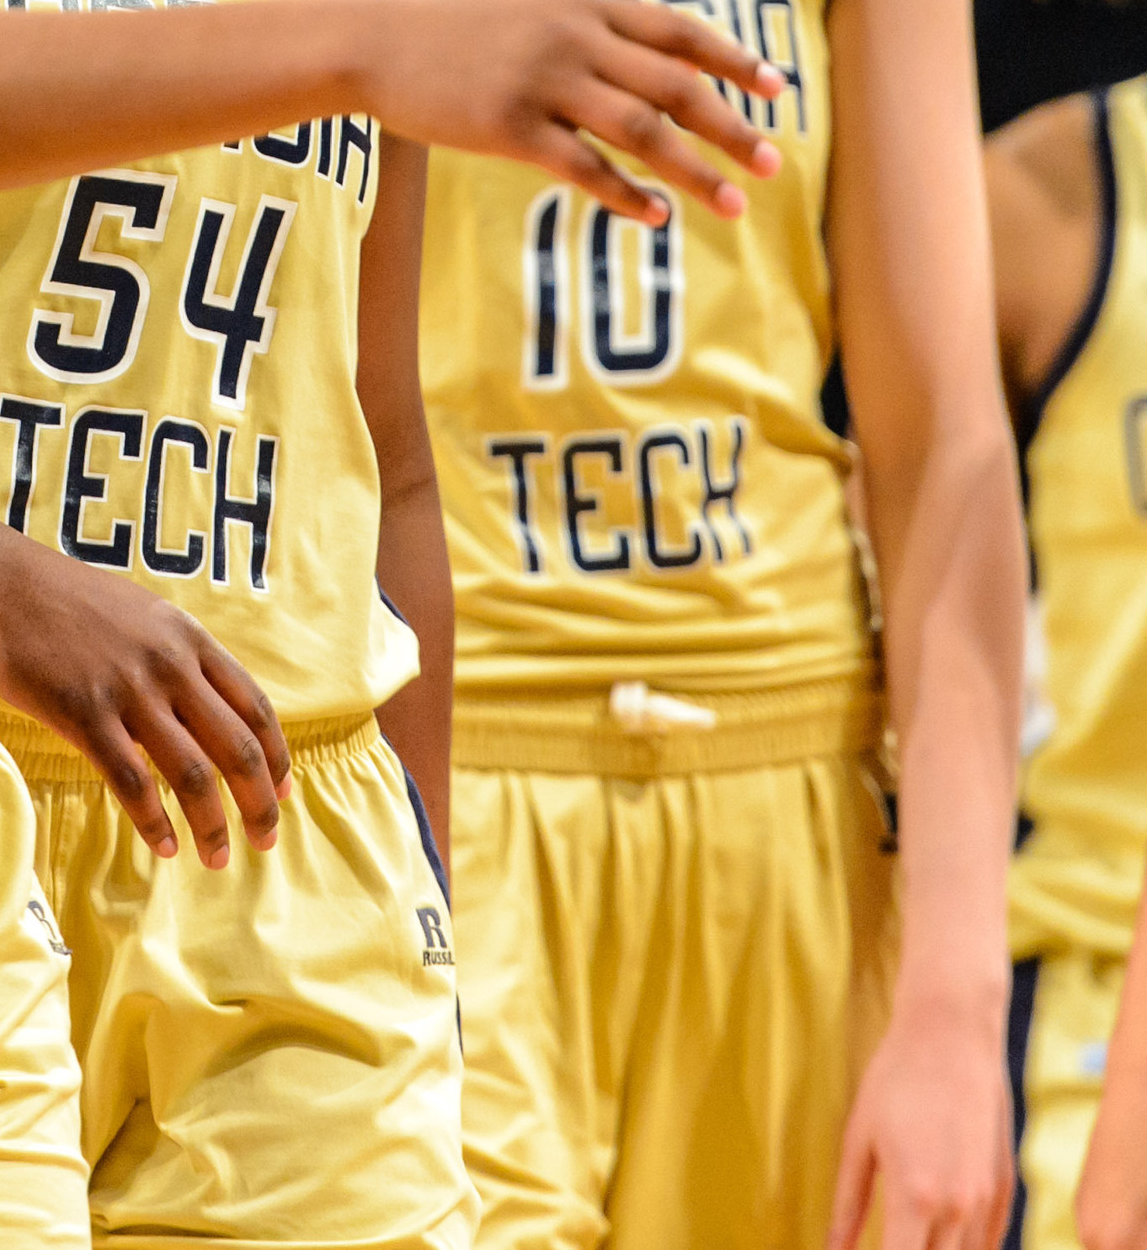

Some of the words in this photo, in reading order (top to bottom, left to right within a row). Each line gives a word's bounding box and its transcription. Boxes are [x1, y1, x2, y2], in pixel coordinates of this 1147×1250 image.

[26, 168, 298, 411] 54
[523, 180, 683, 390] 10
[483, 416, 756, 580] TECH
[416, 906, 447, 948] R
